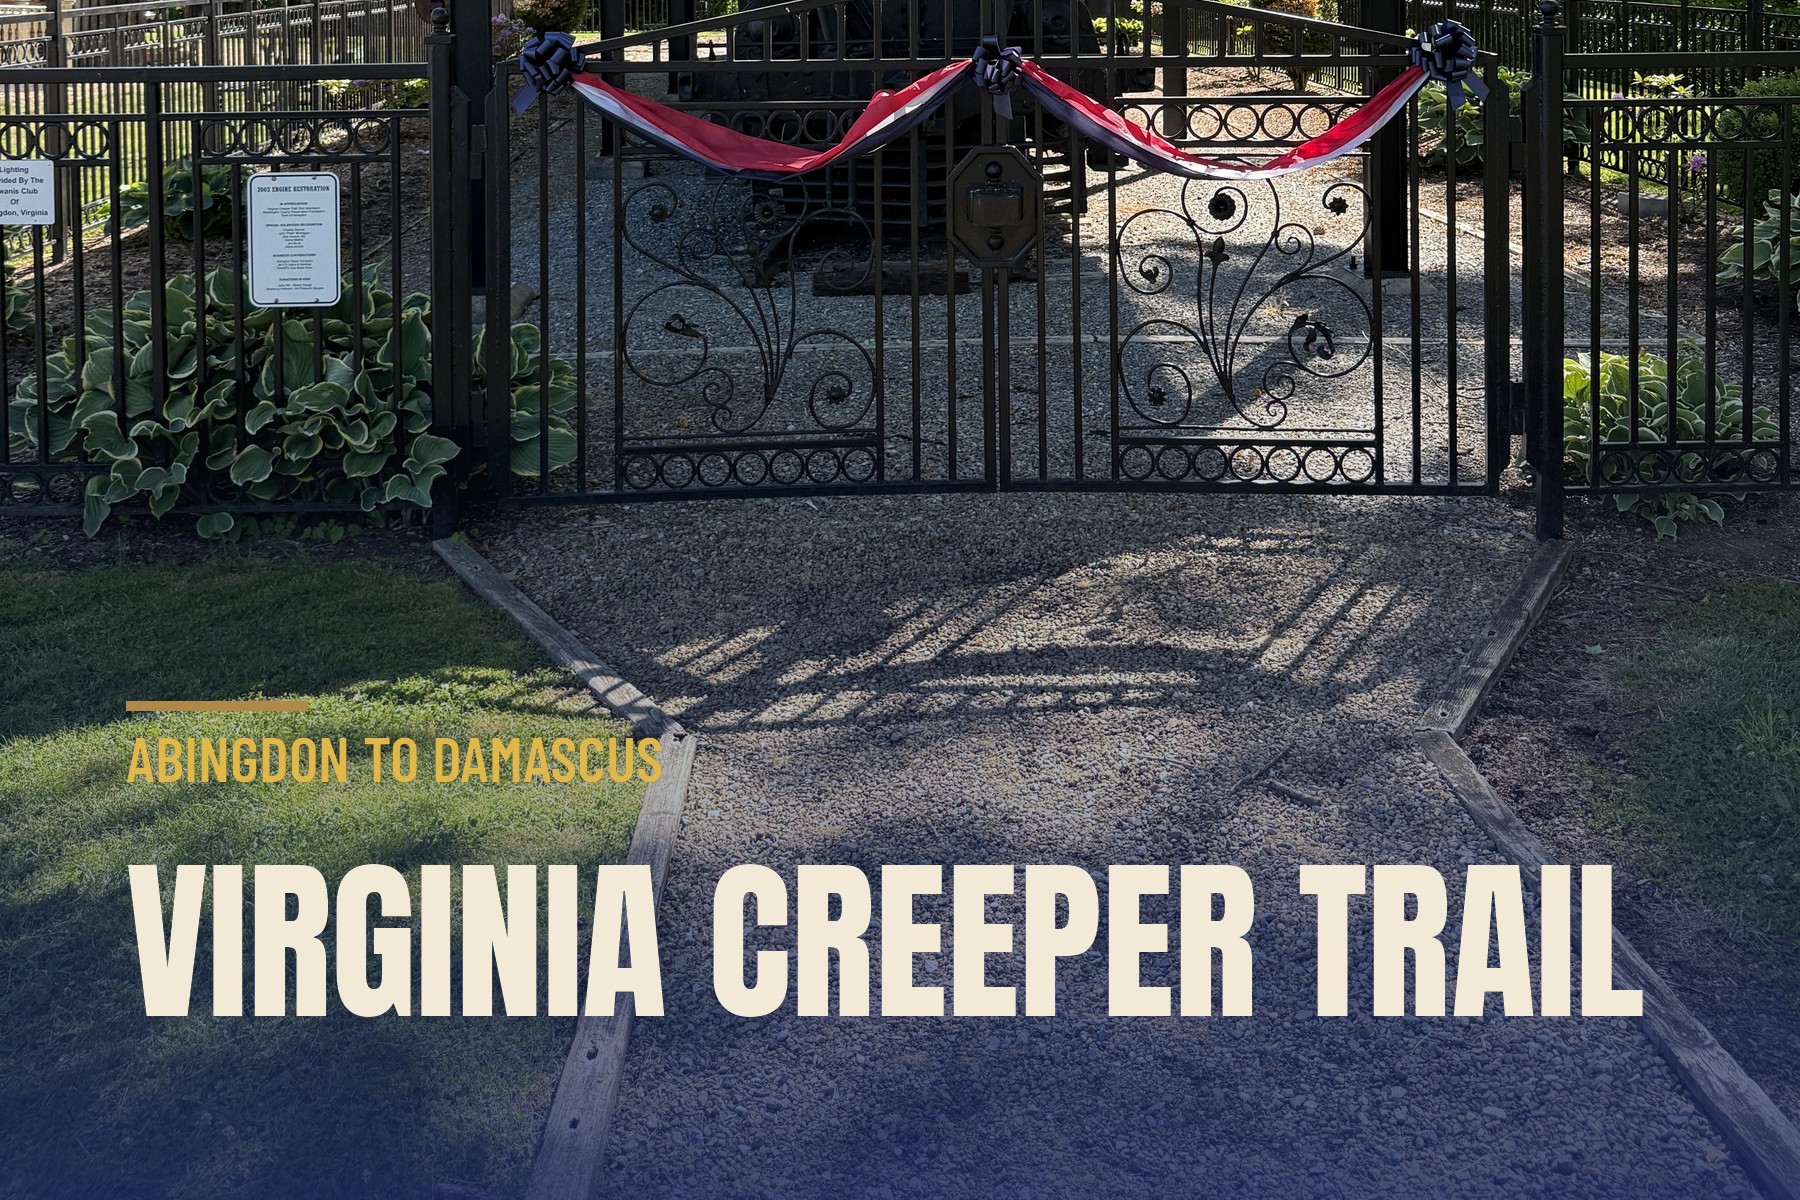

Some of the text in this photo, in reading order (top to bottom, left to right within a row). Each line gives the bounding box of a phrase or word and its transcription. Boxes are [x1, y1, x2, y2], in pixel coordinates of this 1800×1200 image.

[0, 166, 29, 174] Lighting
[18, 177, 29, 185] By
[21, 187, 39, 195] Club
[20, 209, 49, 217] Virginia
